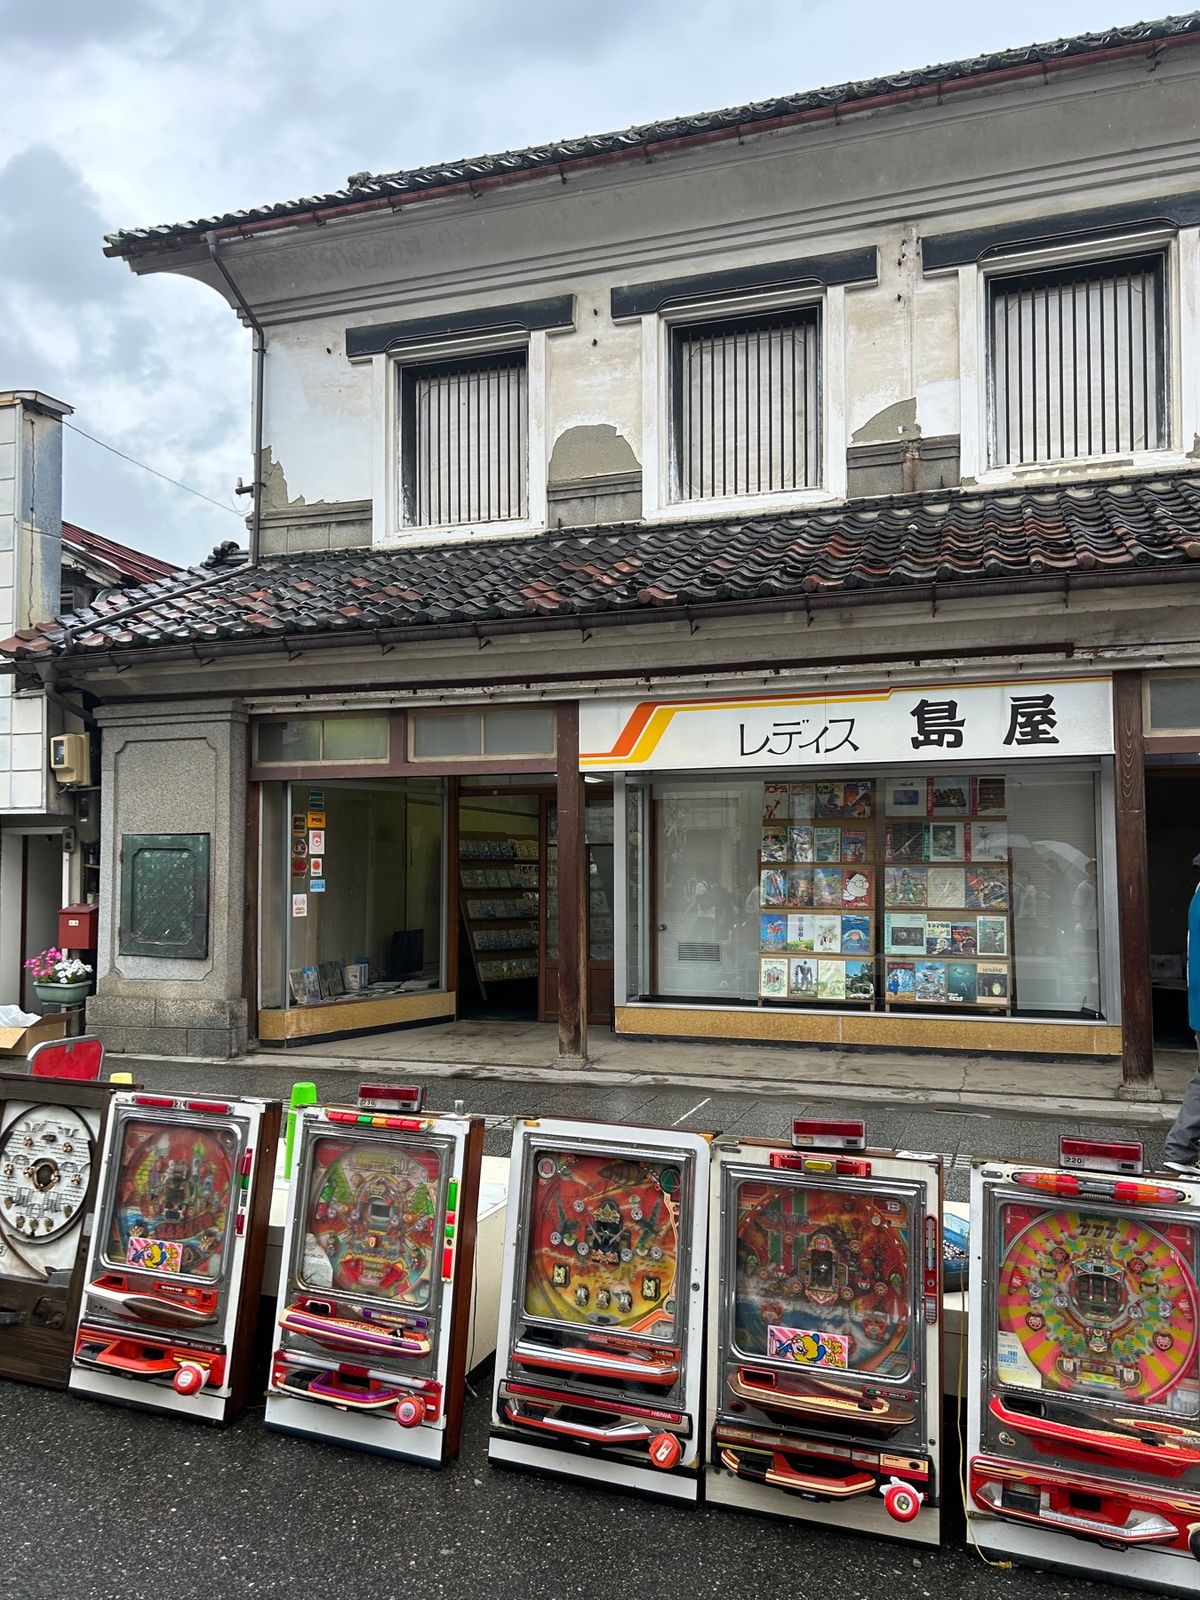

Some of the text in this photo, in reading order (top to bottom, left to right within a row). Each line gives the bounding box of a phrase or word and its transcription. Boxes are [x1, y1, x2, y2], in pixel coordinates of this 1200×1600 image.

[910, 694, 1060, 750] 島屋
[1066, 1156, 1082, 1164] 220
[651, 1410, 673, 1421] HEIWA
